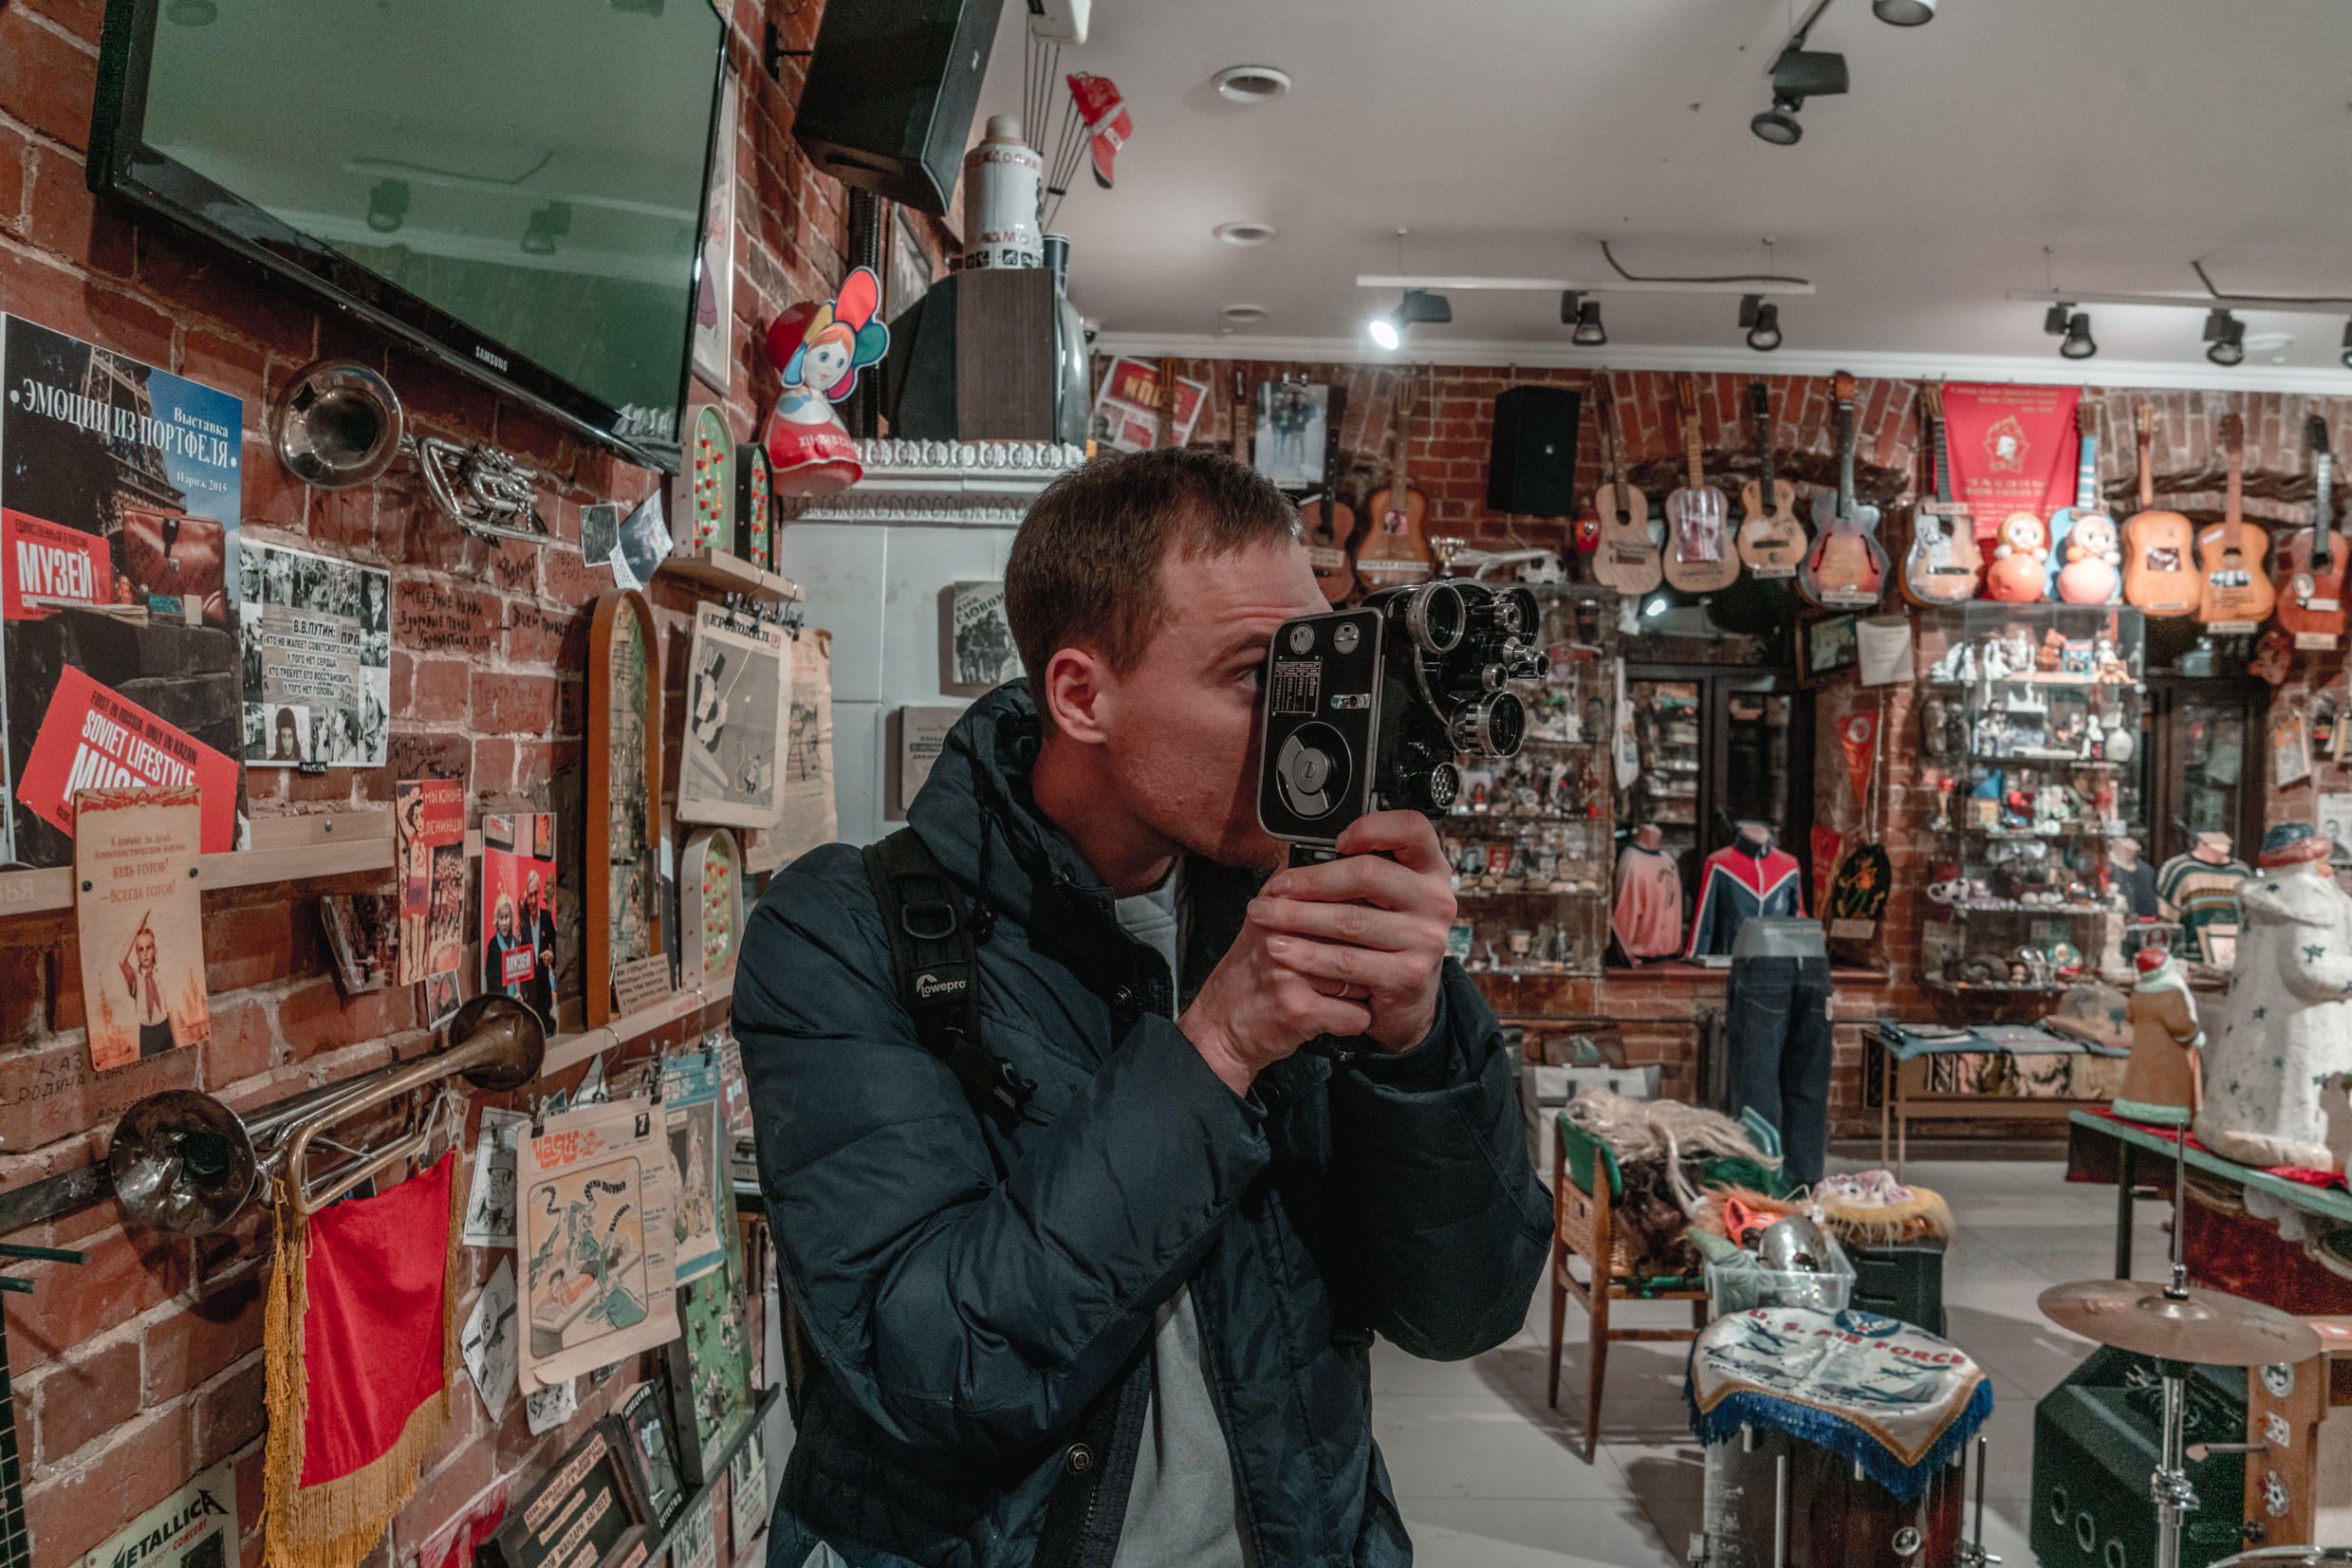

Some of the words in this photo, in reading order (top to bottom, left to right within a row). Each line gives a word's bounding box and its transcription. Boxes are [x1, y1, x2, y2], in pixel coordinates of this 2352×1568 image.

[474, 345, 508, 373] SAMSUNG
[23, 378, 111, 434] ЭМОЦИИ
[113, 406, 137, 442] ИЗ
[140, 415, 229, 469] ПОРТФЕЛЯ
[174, 407, 229, 438] Выставка
[176, 470, 208, 490] Париж
[208, 479, 228, 494] 2015
[16, 540, 93, 600] МУЗЕЙ
[293, 618, 336, 638] В.В.ПУТИН:
[277, 636, 287, 647] НЕ
[286, 638, 307, 651] ЖАЛЕЕТ
[308, 641, 341, 655] СОВЕТСКОГО
[287, 653, 291, 663] У
[291, 653, 306, 665] ТОГО
[306, 655, 317, 666] НЕТ
[269, 666, 280, 677] КТО
[279, 668, 303, 680] ТРЕБУЕТ
[303, 669, 314, 681] ЕГО
[284, 682, 288, 692] У
[288, 682, 302, 694] ТОГО
[302, 683, 313, 695] НЕТ
[90, 691, 111, 713] FIRST
[108, 699, 119, 718] IN
[145, 723, 162, 747] ONLY
[162, 733, 173, 751] IN
[173, 738, 198, 766] KAZAN
[82, 709, 128, 759] SOVIET
[126, 734, 195, 786] LIFESTYLE
[424, 789, 438, 805] МЫ
[437, 787, 463, 805] ЮНЫЕ
[424, 817, 464, 836] ЛЕНИНЦЫ
[113, 864, 135, 878] БУДЬ
[137, 857, 169, 877] ГОТОВ!
[146, 878, 176, 898] ГОТОВ!
[506, 950, 531, 972] МУЗЕЙ
[920, 980, 967, 998] Lowepro
[39, 1051, 86, 1078] КАЗ
[1814, 1330, 1862, 1345] AIR
[1874, 1341, 1966, 1366] FORCE
[111, 1488, 230, 1568] METALLICA
[173, 1518, 208, 1552] CONCERT
[557, 1521, 586, 1559] ЖАНДАРМ
[585, 1493, 609, 1525] НАГЛЕЕТ
